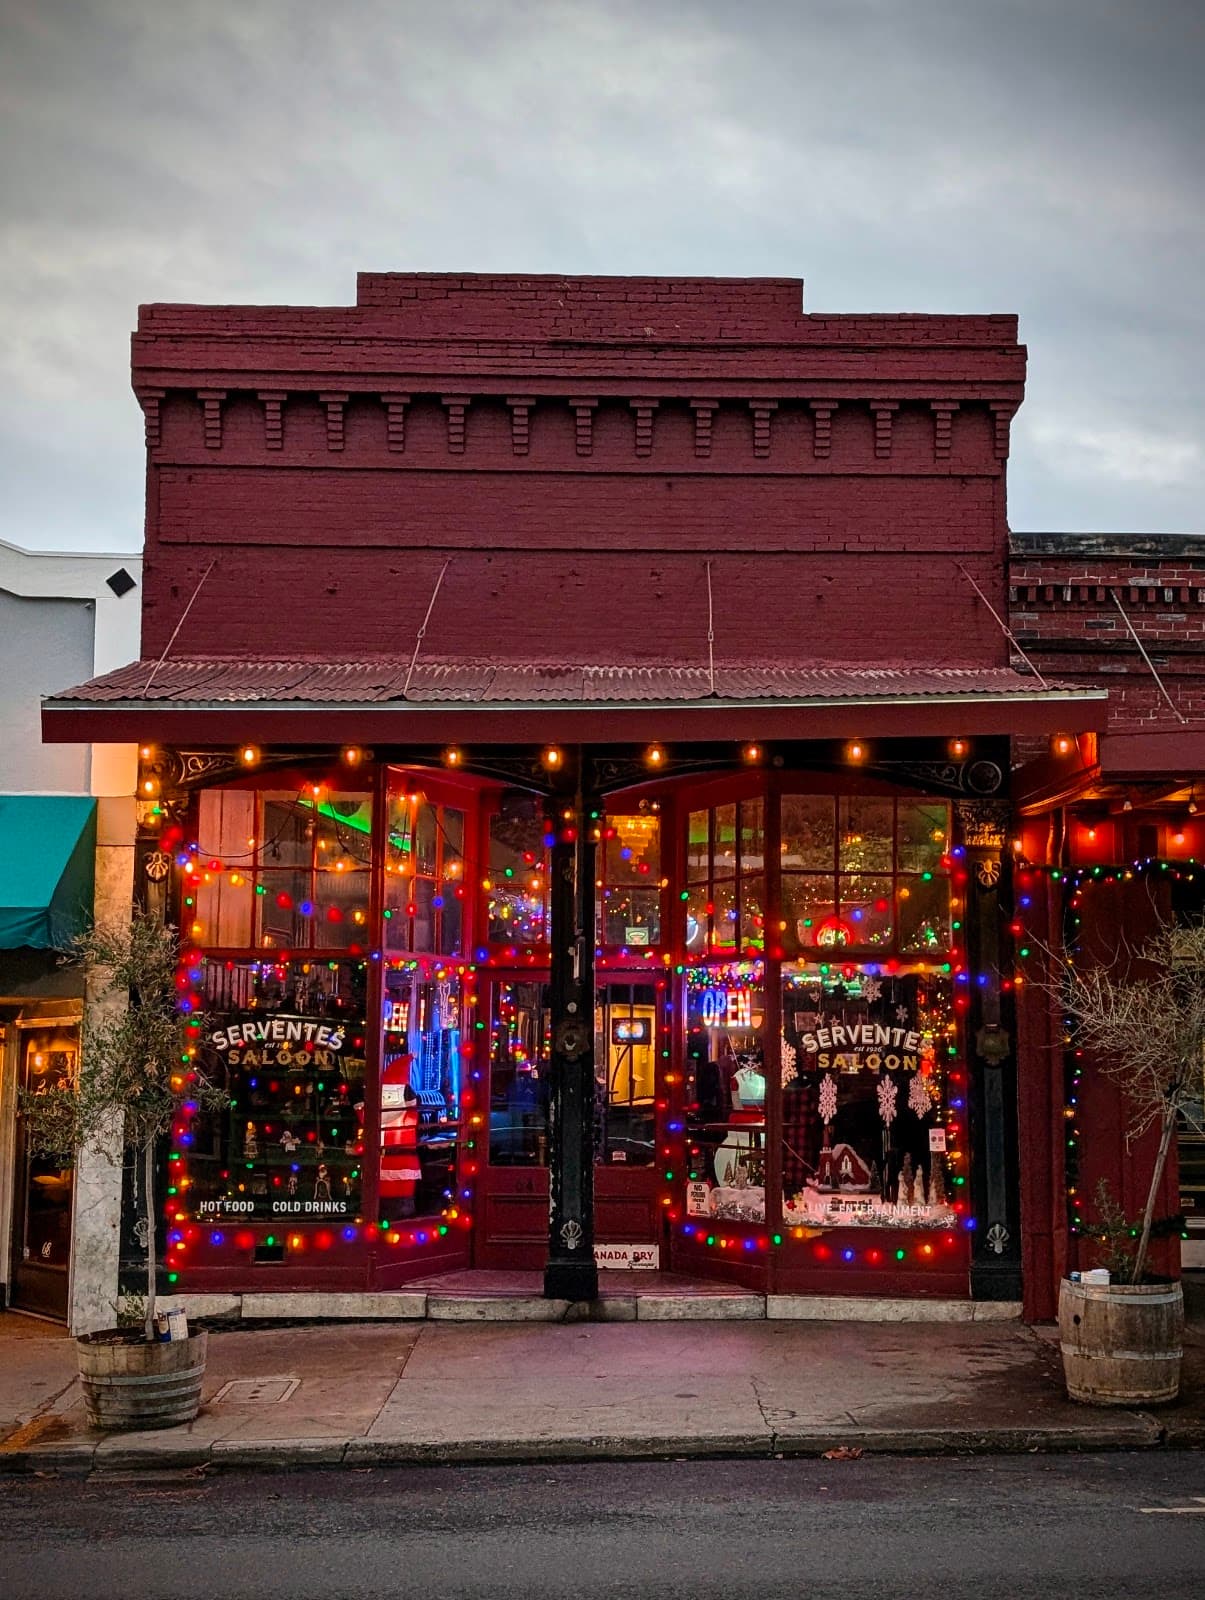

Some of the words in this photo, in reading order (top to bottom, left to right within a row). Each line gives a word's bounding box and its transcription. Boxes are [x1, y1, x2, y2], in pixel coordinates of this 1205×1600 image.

[384, 1000, 409, 1032] PEN
[703, 989, 750, 1027] OPEN
[212, 1020, 346, 1050] SERVENTES
[802, 1024, 934, 1054] SERVENTES
[228, 1050, 328, 1065] SALOON
[818, 1053, 917, 1071] SALOON
[200, 1201, 222, 1213] HOT
[226, 1201, 254, 1213] FOOD
[272, 1201, 300, 1213] COLD
[305, 1201, 347, 1213] DRINKS
[808, 1203, 832, 1214] LIVE
[839, 1203, 932, 1217] ENTERTAINMENT
[593, 1251, 628, 1260] ANADA
[633, 1251, 654, 1261] DRY
